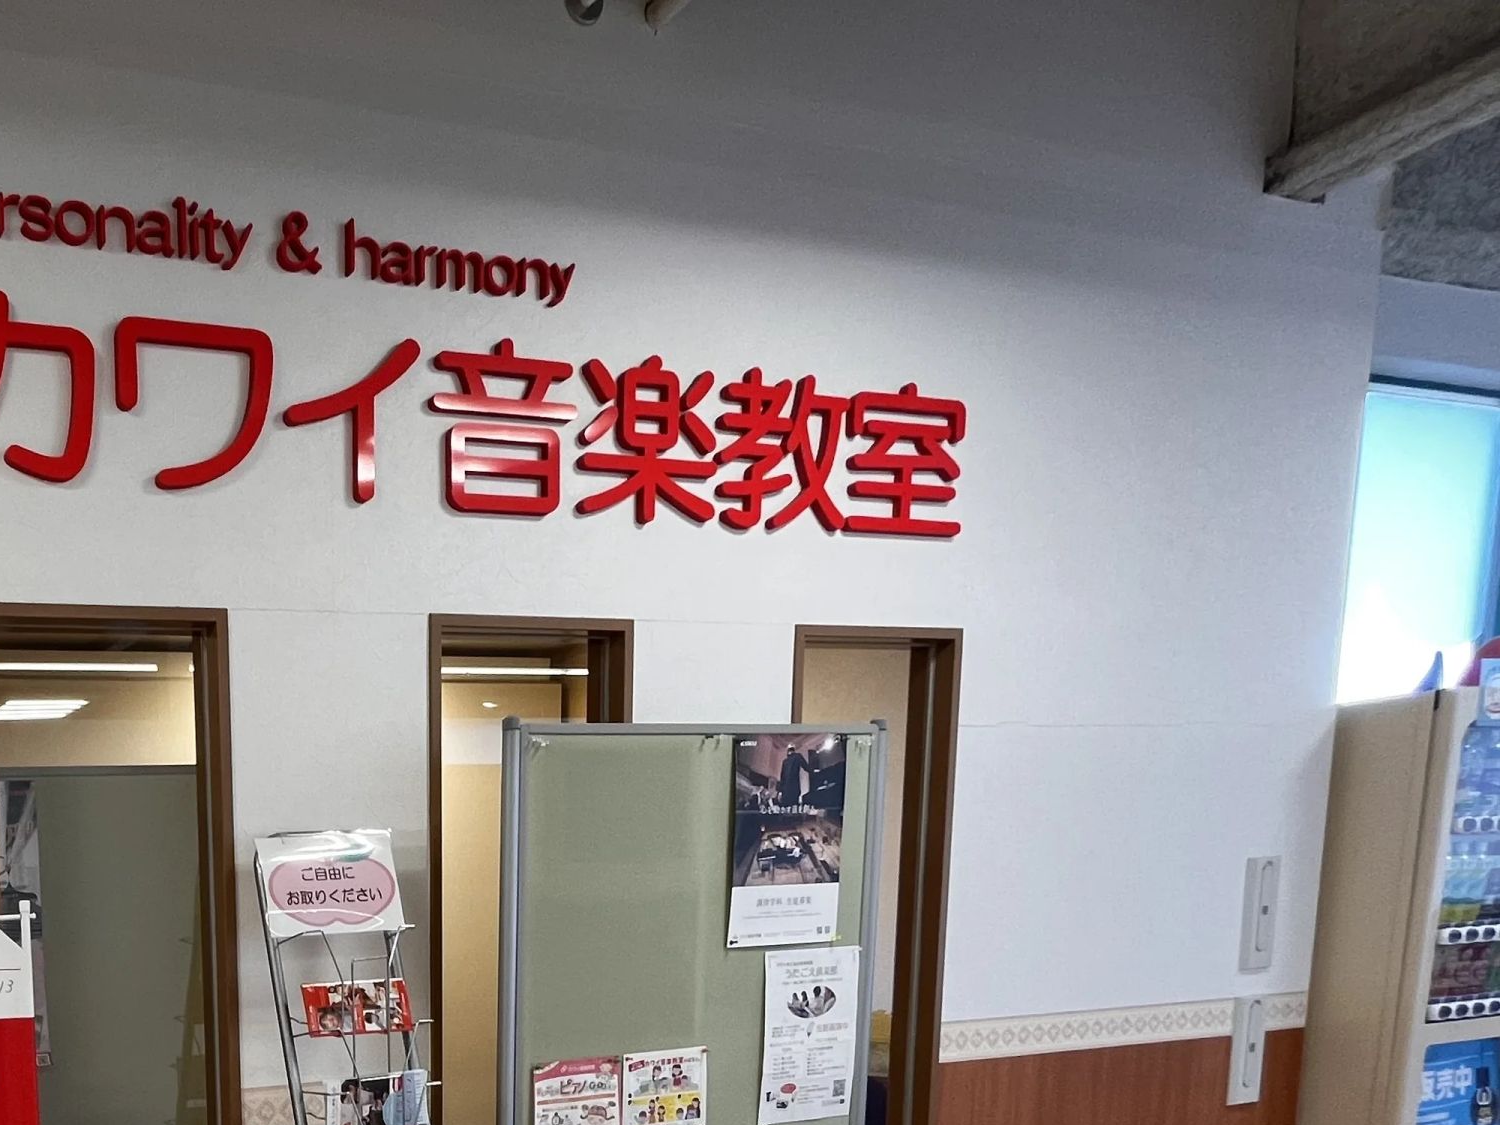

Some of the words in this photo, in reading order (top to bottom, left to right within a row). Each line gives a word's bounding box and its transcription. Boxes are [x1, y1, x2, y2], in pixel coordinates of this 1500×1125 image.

[275, 210, 322, 275] &
[343, 217, 576, 307] harmony
[301, 866, 355, 882] ご自由に
[286, 887, 383, 906] お取りください
